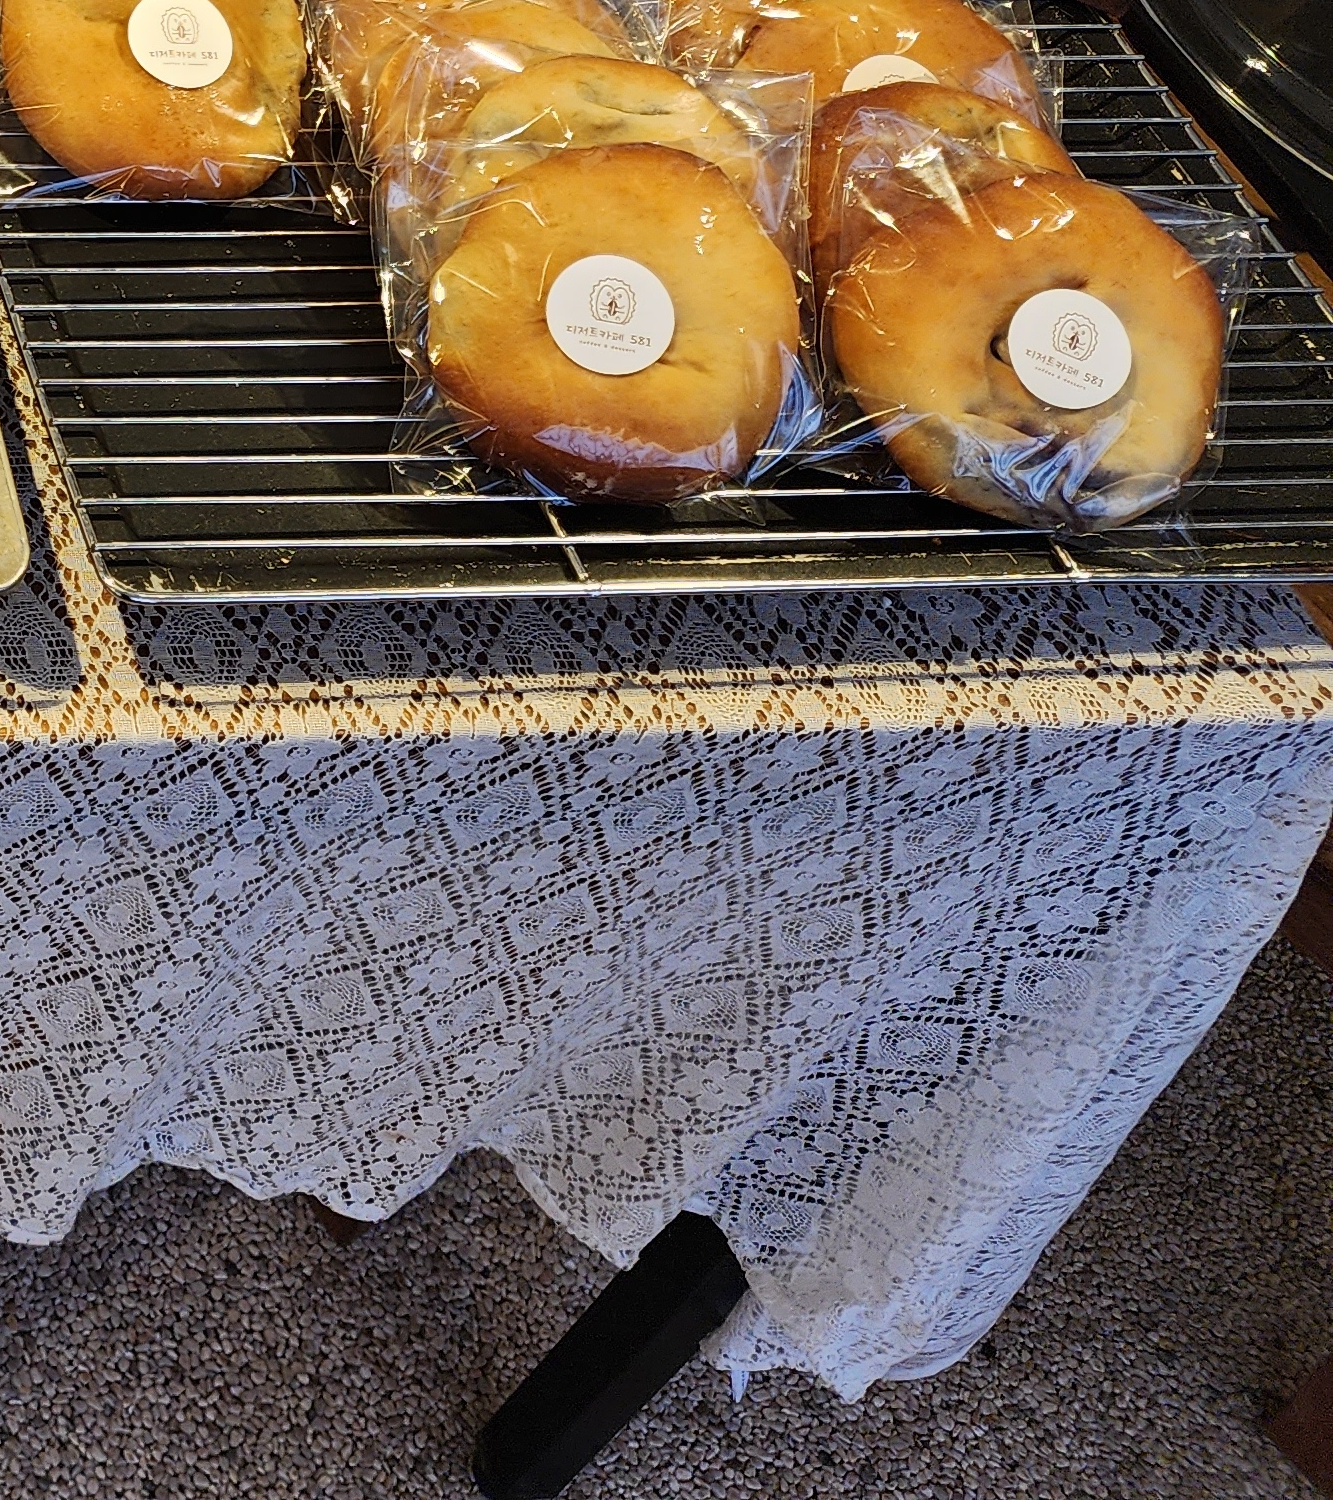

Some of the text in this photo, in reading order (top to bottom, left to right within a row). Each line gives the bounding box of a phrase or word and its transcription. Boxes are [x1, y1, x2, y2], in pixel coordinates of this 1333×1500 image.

[201, 51, 219, 60] 581
[565, 324, 652, 348] 디저트카페 581
[1025, 348, 1105, 389] 디저트카페 581
